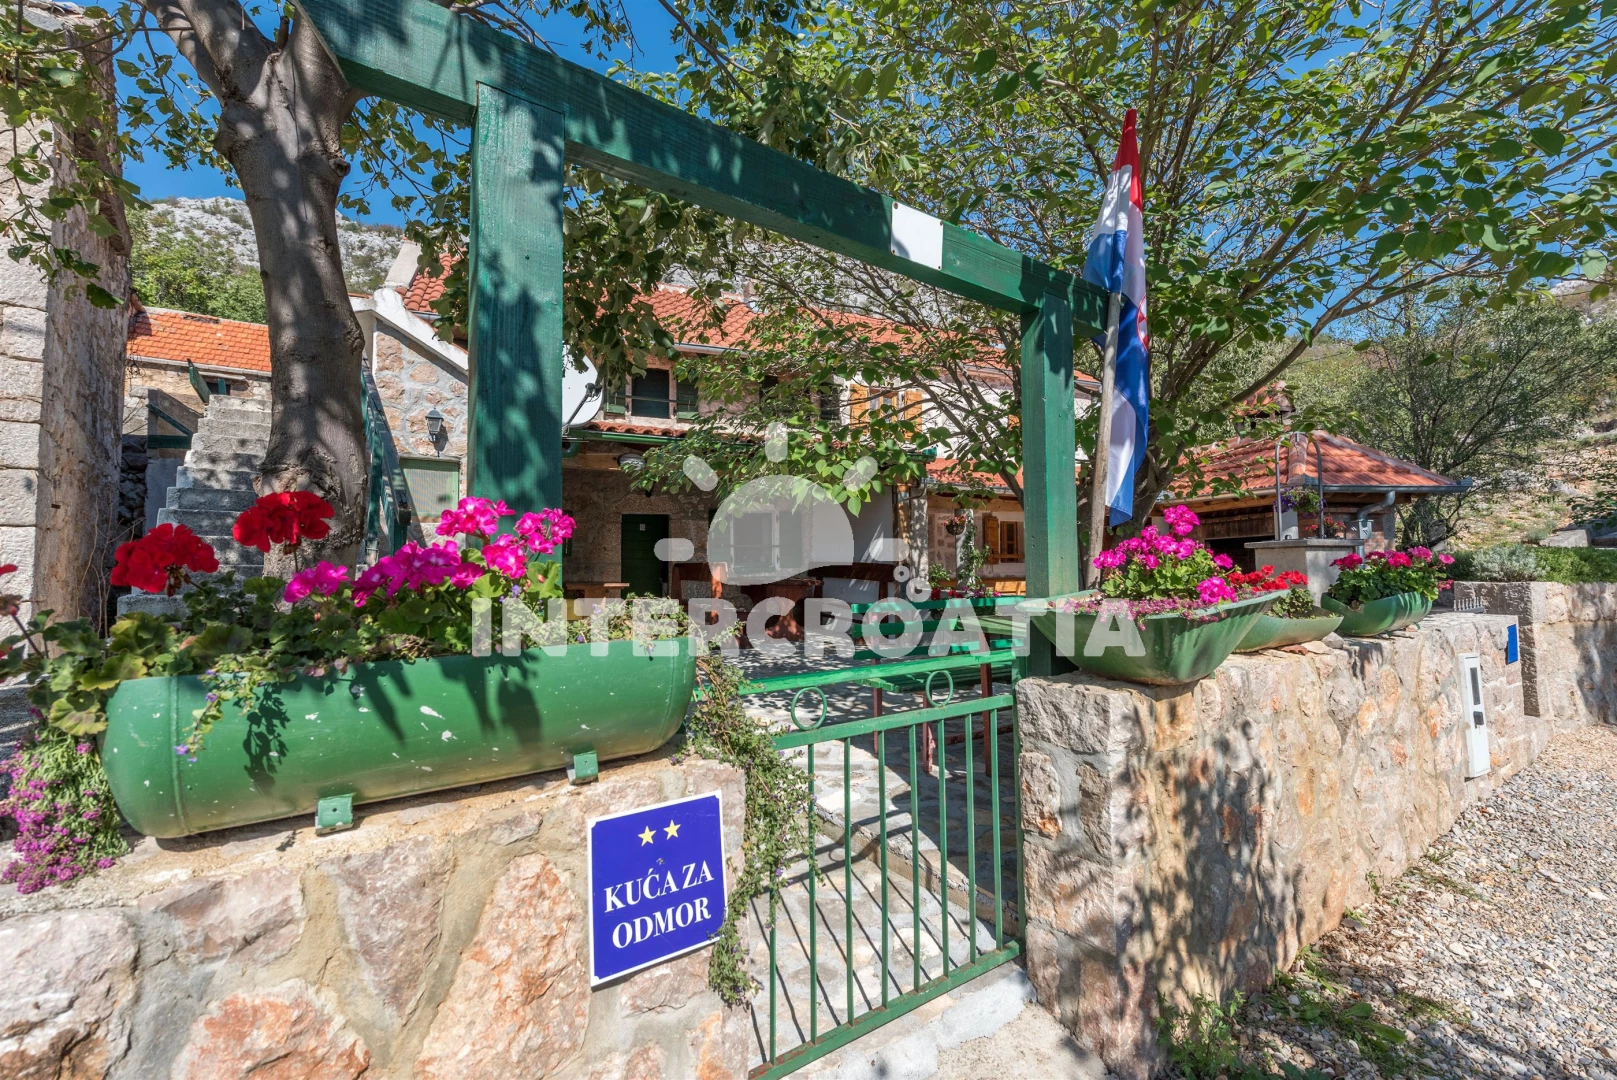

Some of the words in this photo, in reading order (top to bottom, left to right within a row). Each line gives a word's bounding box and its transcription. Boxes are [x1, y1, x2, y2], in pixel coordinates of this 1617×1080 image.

[604, 868, 679, 913] KUĆA
[682, 860, 714, 889] ZA
[612, 897, 711, 949] ODMOR
